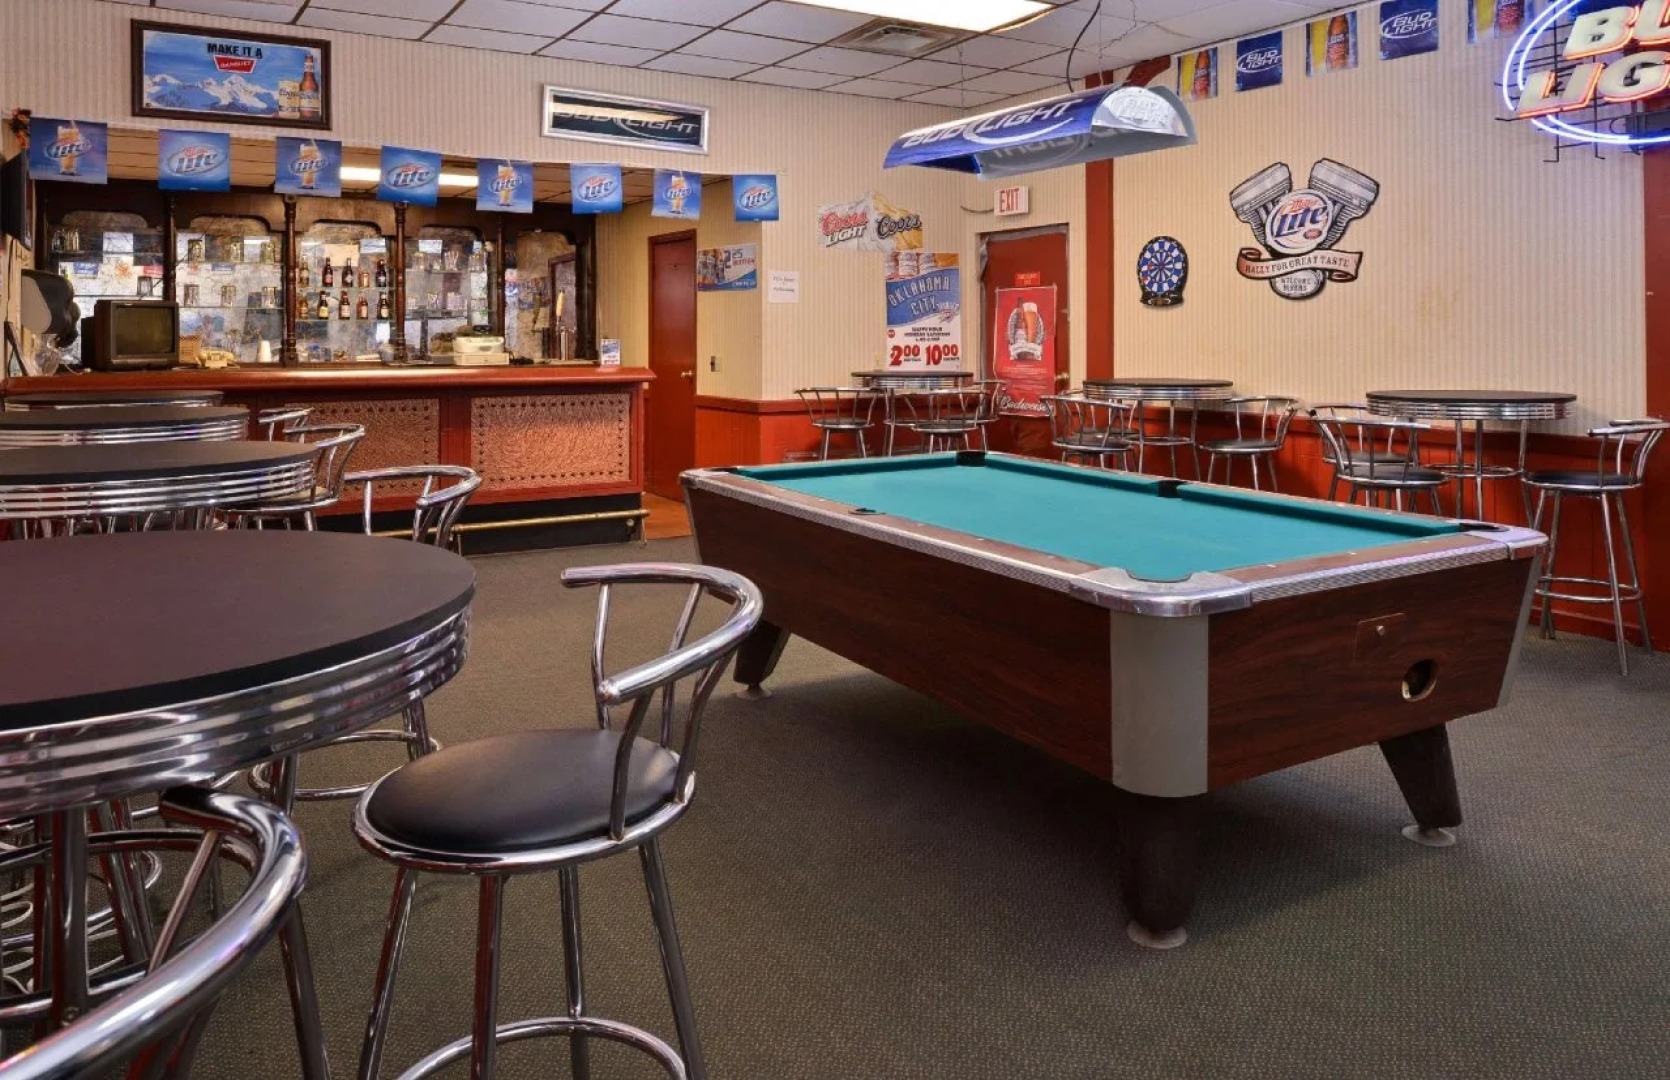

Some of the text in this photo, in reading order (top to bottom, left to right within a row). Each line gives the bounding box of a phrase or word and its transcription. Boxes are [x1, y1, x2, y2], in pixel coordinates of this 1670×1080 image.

[1385, 17, 1436, 35] LIGHT
[1394, 11, 1432, 27] BUD
[207, 42, 239, 56] MAKE
[255, 47, 263, 60] A
[1246, 50, 1278, 62] BUD
[1239, 54, 1282, 70] LIGHT
[902, 127, 963, 148] BUD
[975, 98, 1084, 133] LIGHT
[1000, 188, 1020, 213] EXIT
[822, 209, 867, 236] Coors
[877, 214, 921, 240] Coors
[1274, 206, 1328, 238] Lite
[826, 225, 866, 248] LIGHT
[1245, 256, 1350, 274] RALLY FOR GREAT TASTE
[888, 276, 951, 307] OKLAHOMA
[911, 295, 938, 315] CITY
